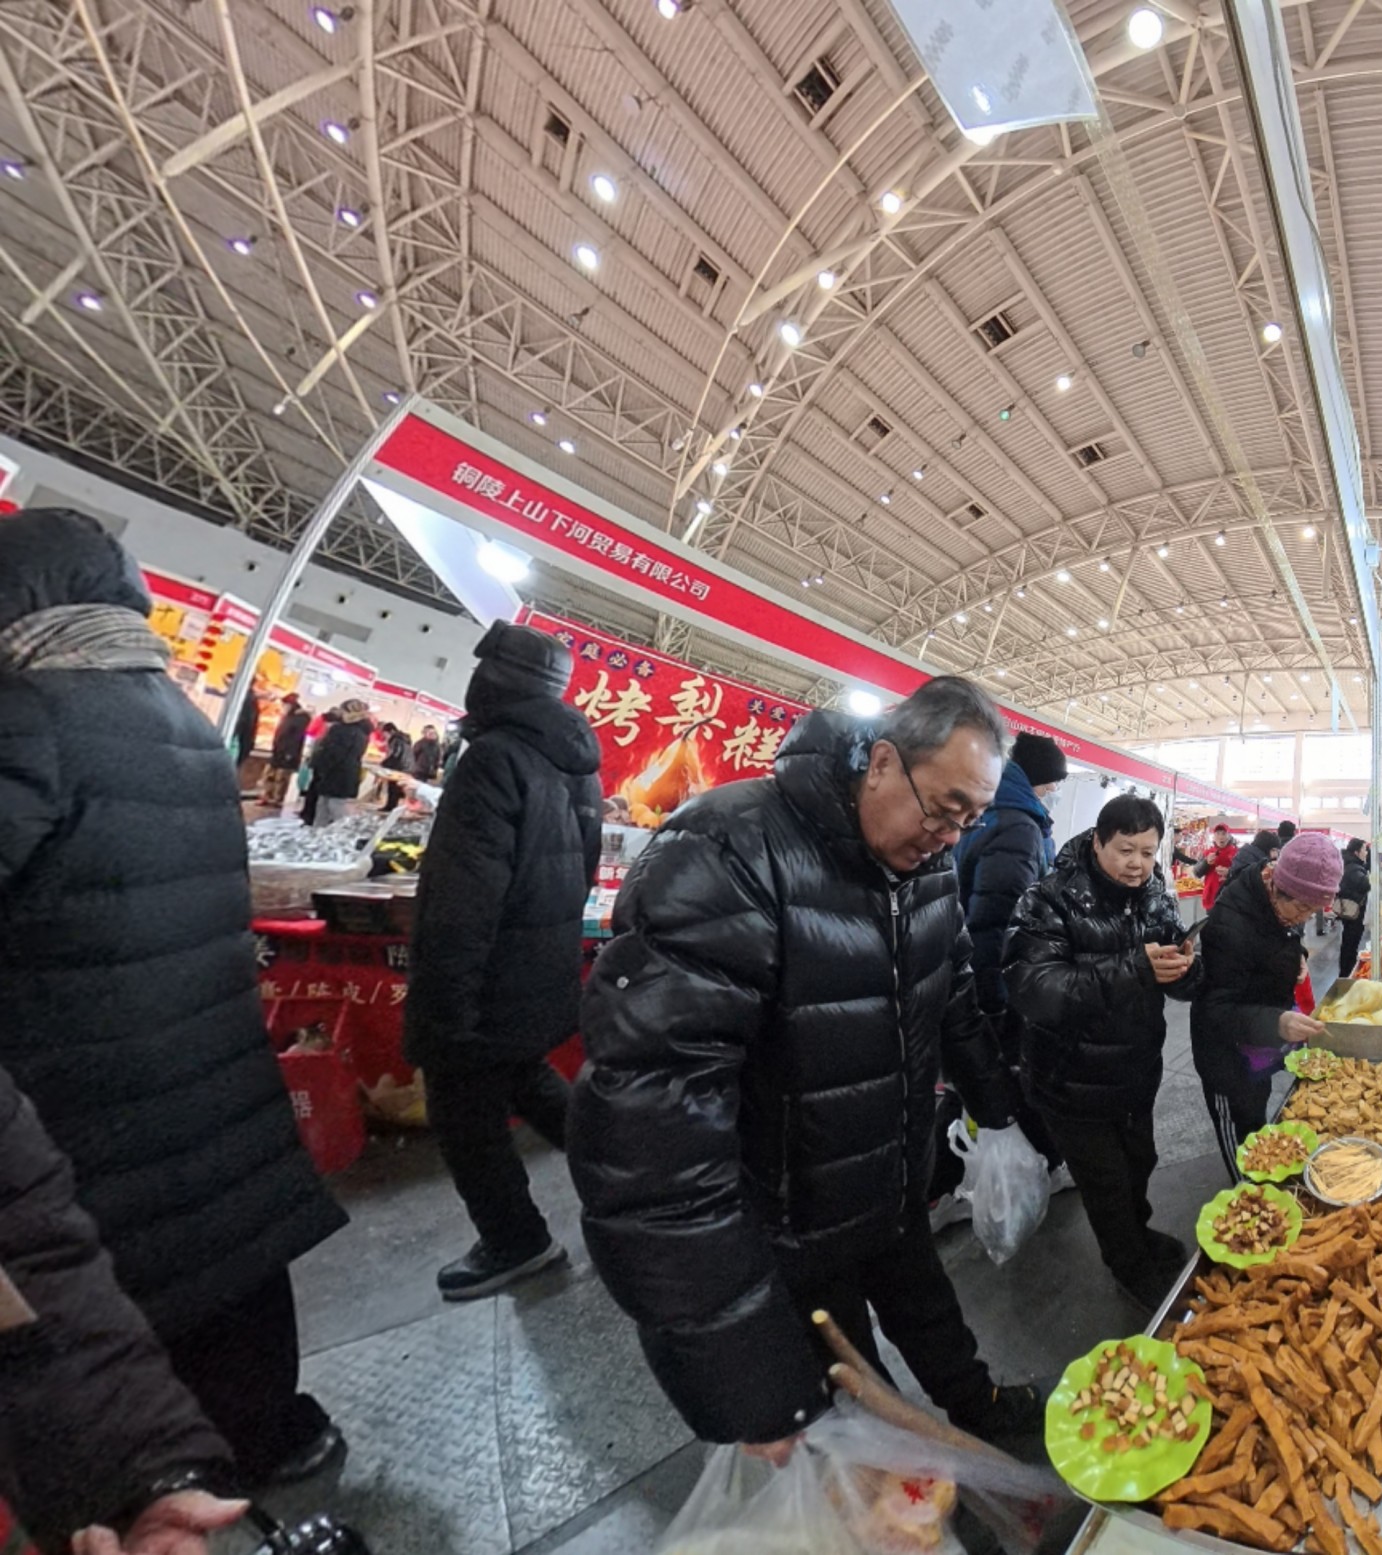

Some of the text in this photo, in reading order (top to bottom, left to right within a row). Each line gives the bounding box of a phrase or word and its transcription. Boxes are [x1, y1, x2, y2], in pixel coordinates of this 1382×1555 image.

[452, 461, 711, 601] 铜陵上山下河贸易有限公司
[574, 670, 787, 771] 烤梨糕
